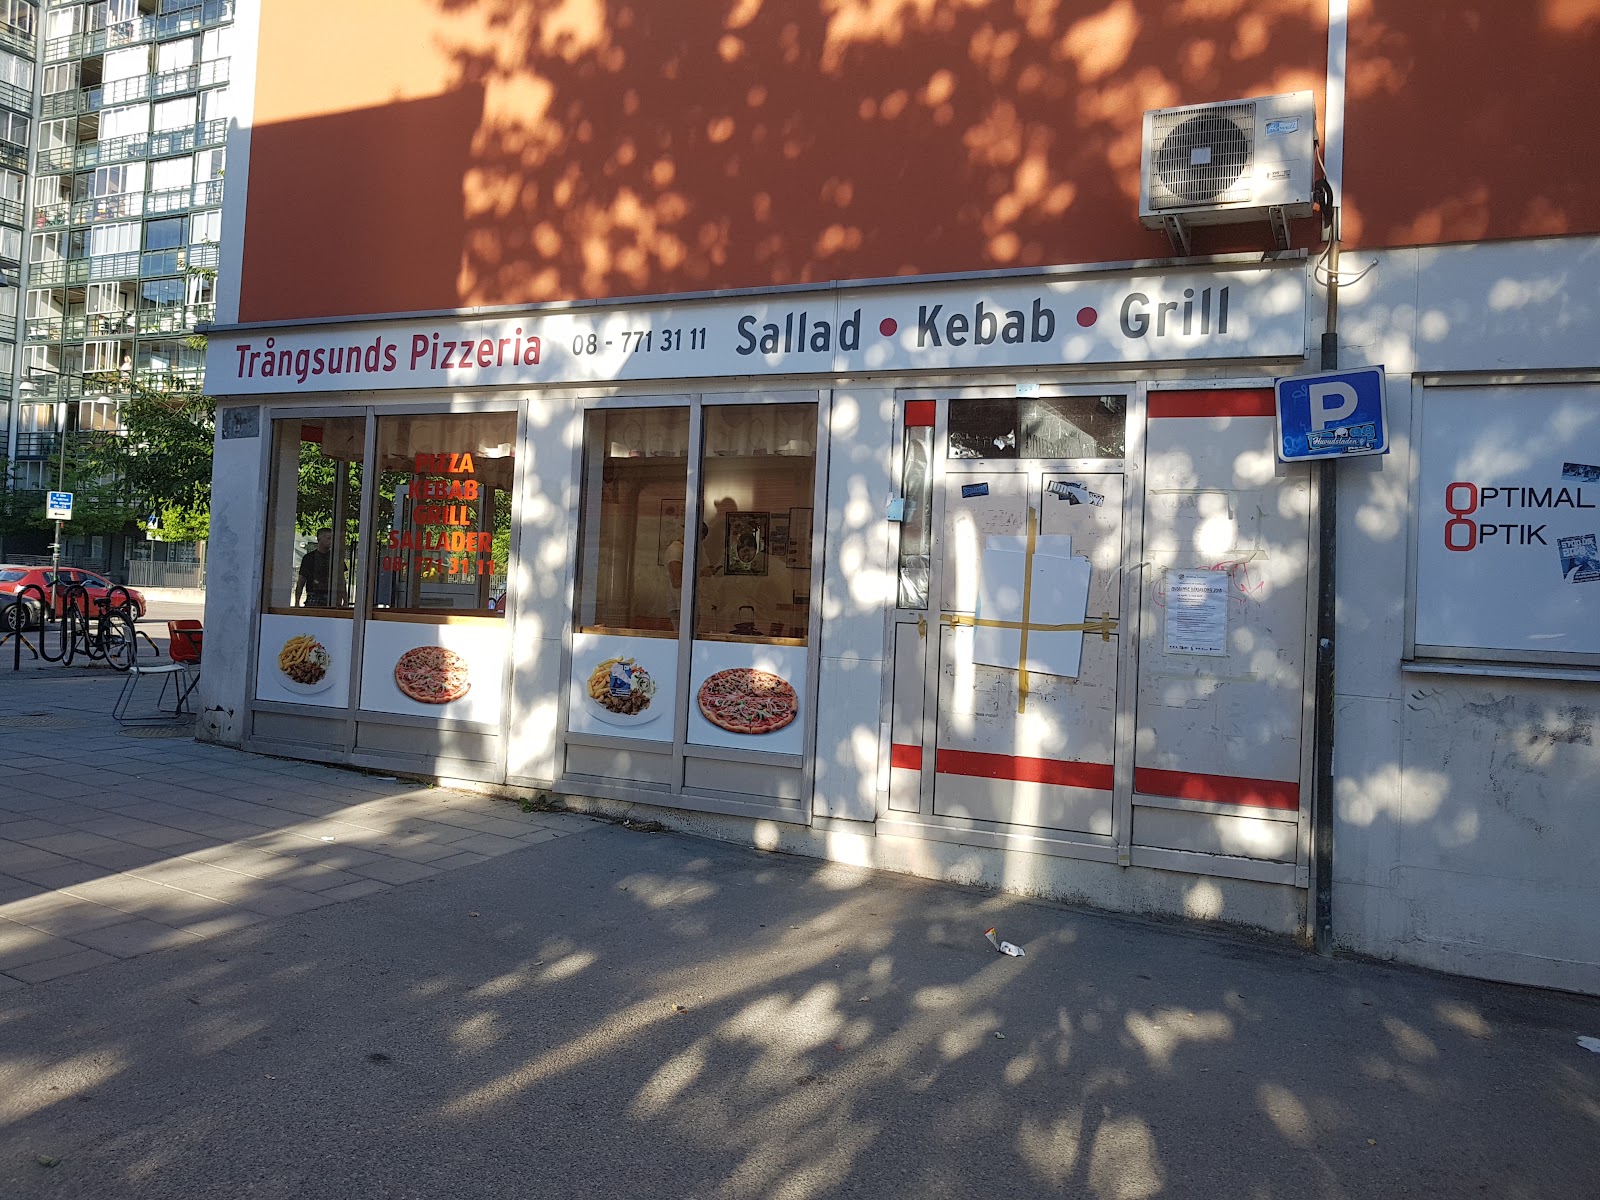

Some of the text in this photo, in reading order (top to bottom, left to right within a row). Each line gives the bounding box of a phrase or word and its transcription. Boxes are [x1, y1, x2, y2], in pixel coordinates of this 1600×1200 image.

[735, 286, 1230, 356] Sallad Kebab Grill
[236, 336, 397, 384] Trångsunds
[410, 328, 540, 370] Pizzeria
[572, 333, 597, 357] 08
[621, 330, 652, 354] 771
[660, 329, 682, 351] 31
[690, 327, 707, 350] 11
[1309, 381, 1359, 432] P
[415, 453, 475, 473] PIZZA
[408, 480, 478, 500] KEBAB
[1445, 482, 1595, 515] OPTIMAL
[413, 505, 470, 525] GRILL
[389, 530, 492, 552] SALLADER
[1445, 519, 1548, 551] OPTIK
